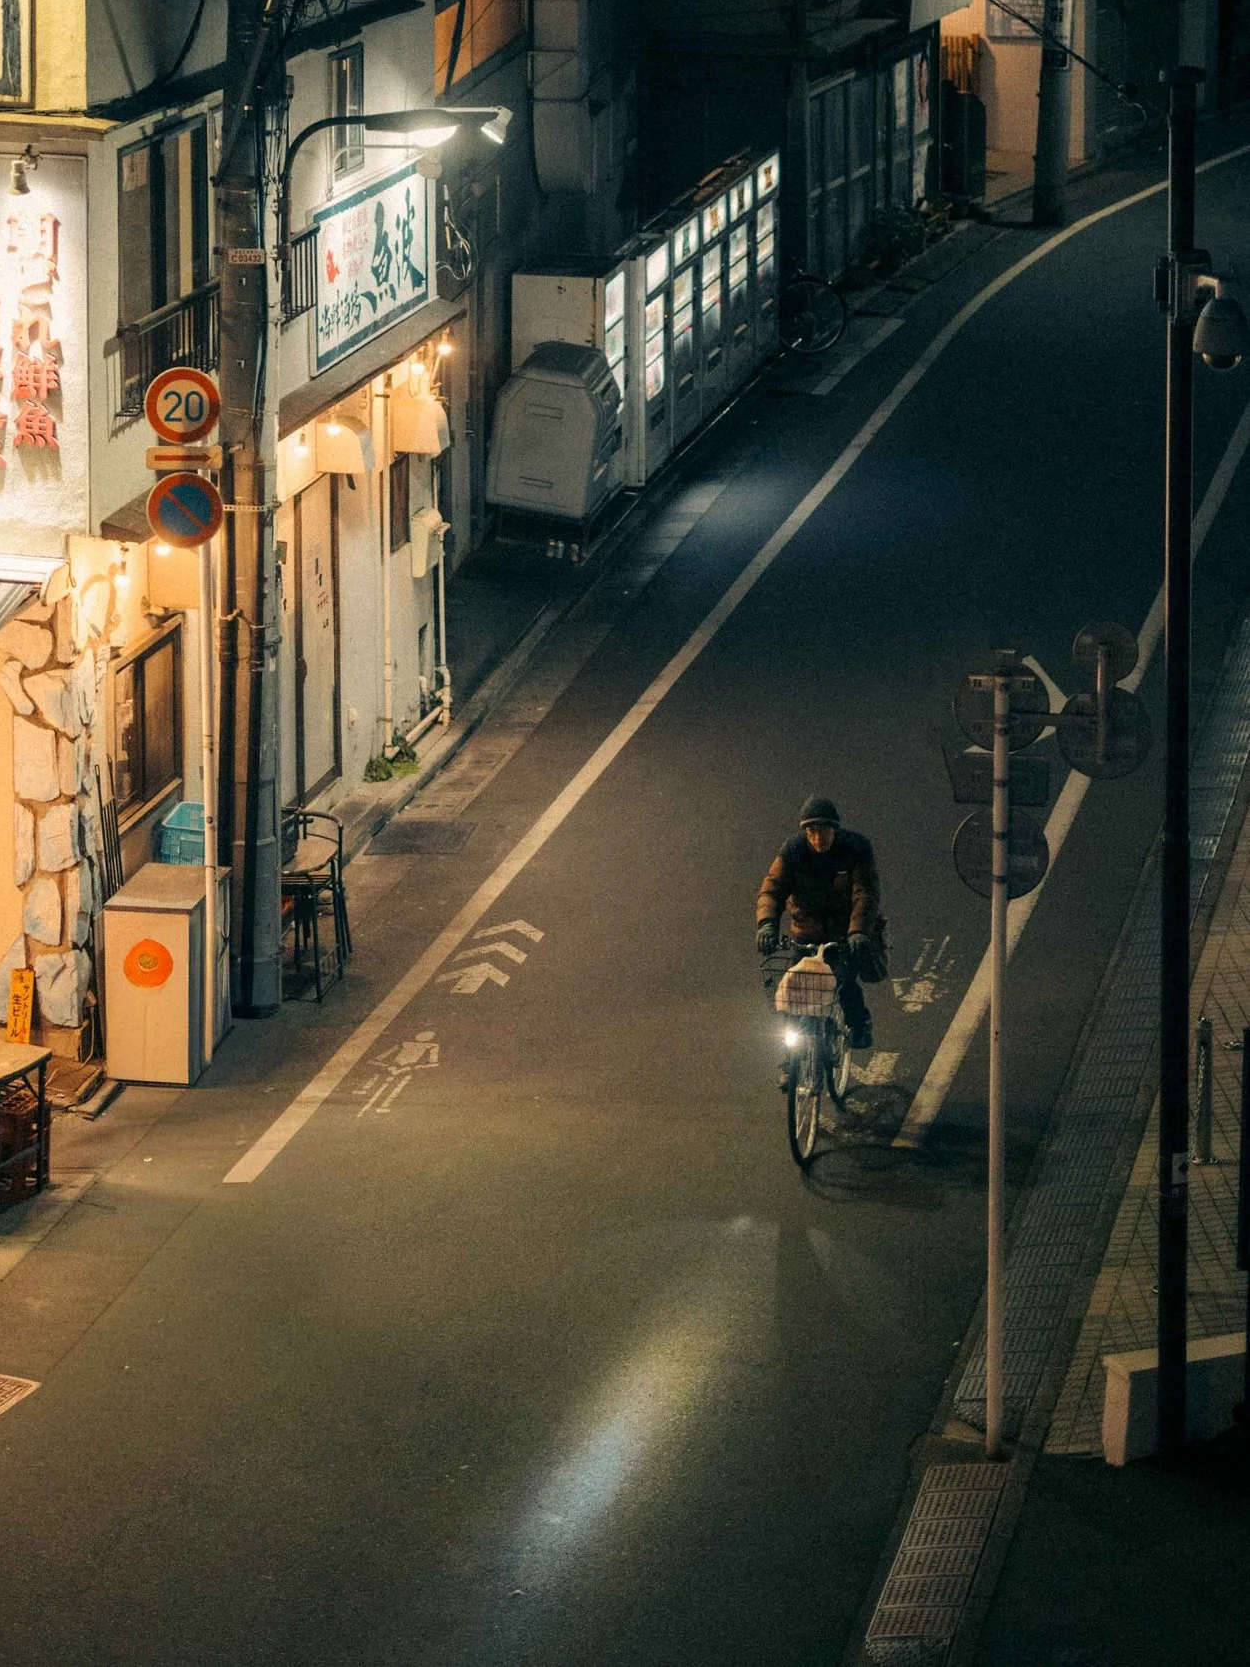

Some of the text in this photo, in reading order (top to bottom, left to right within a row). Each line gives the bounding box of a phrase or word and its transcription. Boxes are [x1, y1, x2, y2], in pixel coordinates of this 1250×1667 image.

[360, 186, 427, 314] 魚波
[163, 390, 205, 423] 20
[10, 994, 22, 1038] 生ビール
